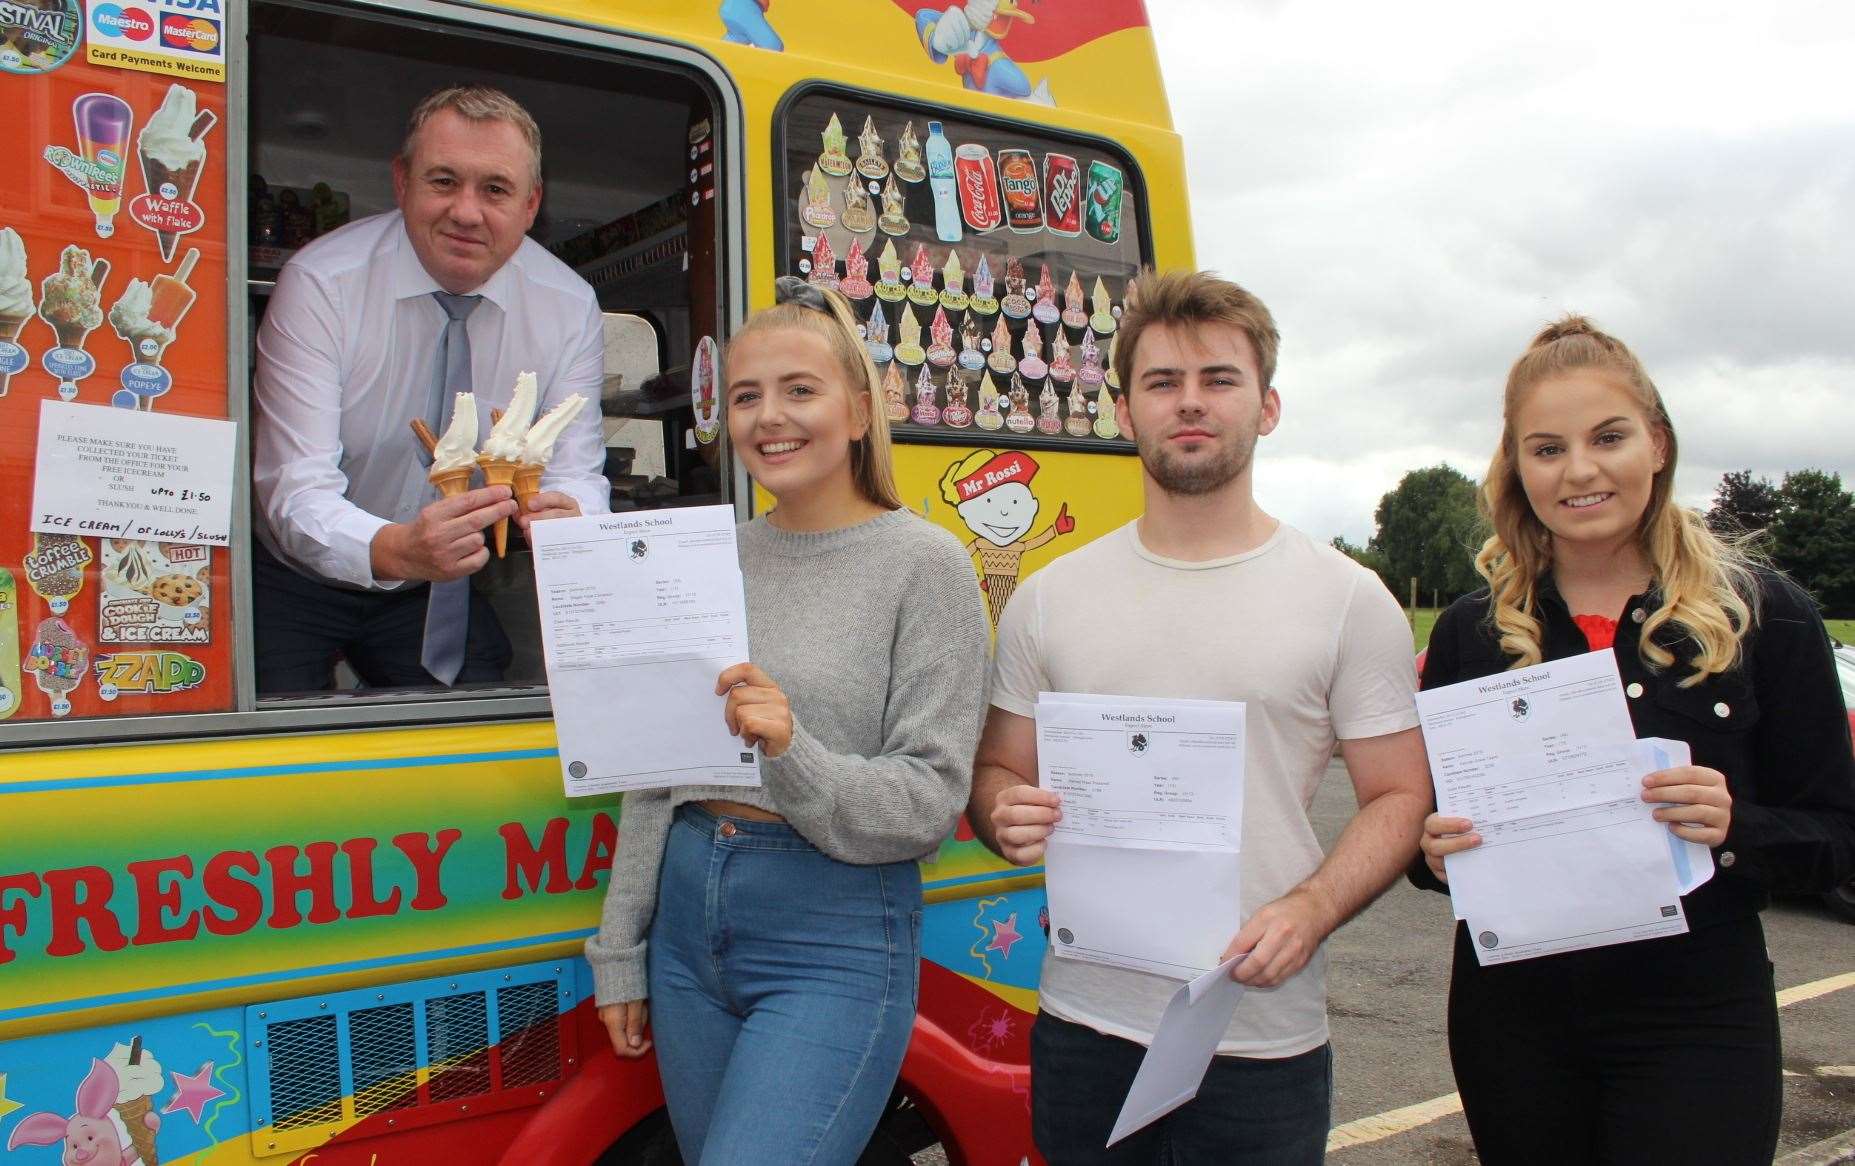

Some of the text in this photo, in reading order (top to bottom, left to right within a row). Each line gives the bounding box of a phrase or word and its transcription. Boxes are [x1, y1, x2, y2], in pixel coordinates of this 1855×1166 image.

[98, 14, 149, 31] Maestro
[163, 25, 218, 42] MasterCard
[92, 49, 221, 76] Card Payments Welcome
[1001, 176, 1036, 195] Tango
[145, 198, 190, 215] Waffle
[142, 212, 163, 225] with
[129, 379, 161, 391] POPEYE
[1007, 416, 1034, 427] nutella
[56, 434, 178, 455] PLEASE MAKE SURE YOU HAVE
[77, 445, 178, 462] COLLECTED YOUR TICKET
[79, 454, 189, 472] FROM THE OFFICE FOR YOUR
[102, 465, 166, 478] FREE ICECREAM
[113, 475, 125, 483] OR
[962, 460, 1024, 497] Mr Rossi
[107, 482, 135, 492] SLUSH
[97, 499, 126, 509] THANK
[144, 503, 151, 511] &
[152, 505, 175, 513] WELL
[175, 507, 199, 515] DONE
[42, 514, 73, 527] ICE
[599, 520, 643, 532] Westlands
[644, 517, 673, 528] School
[28, 541, 81, 568] Coffee
[174, 548, 202, 560] HOT
[30, 550, 89, 580] CRUMBLE
[103, 602, 159, 617] COOKIE
[109, 613, 157, 626] DOUGH
[101, 626, 208, 642] & ICE CREAM
[1478, 678, 1521, 695] Westlands
[1522, 671, 1552, 685] School
[1101, 713, 1176, 724] Westlands School
[0, 829, 462, 965] FRESHLY
